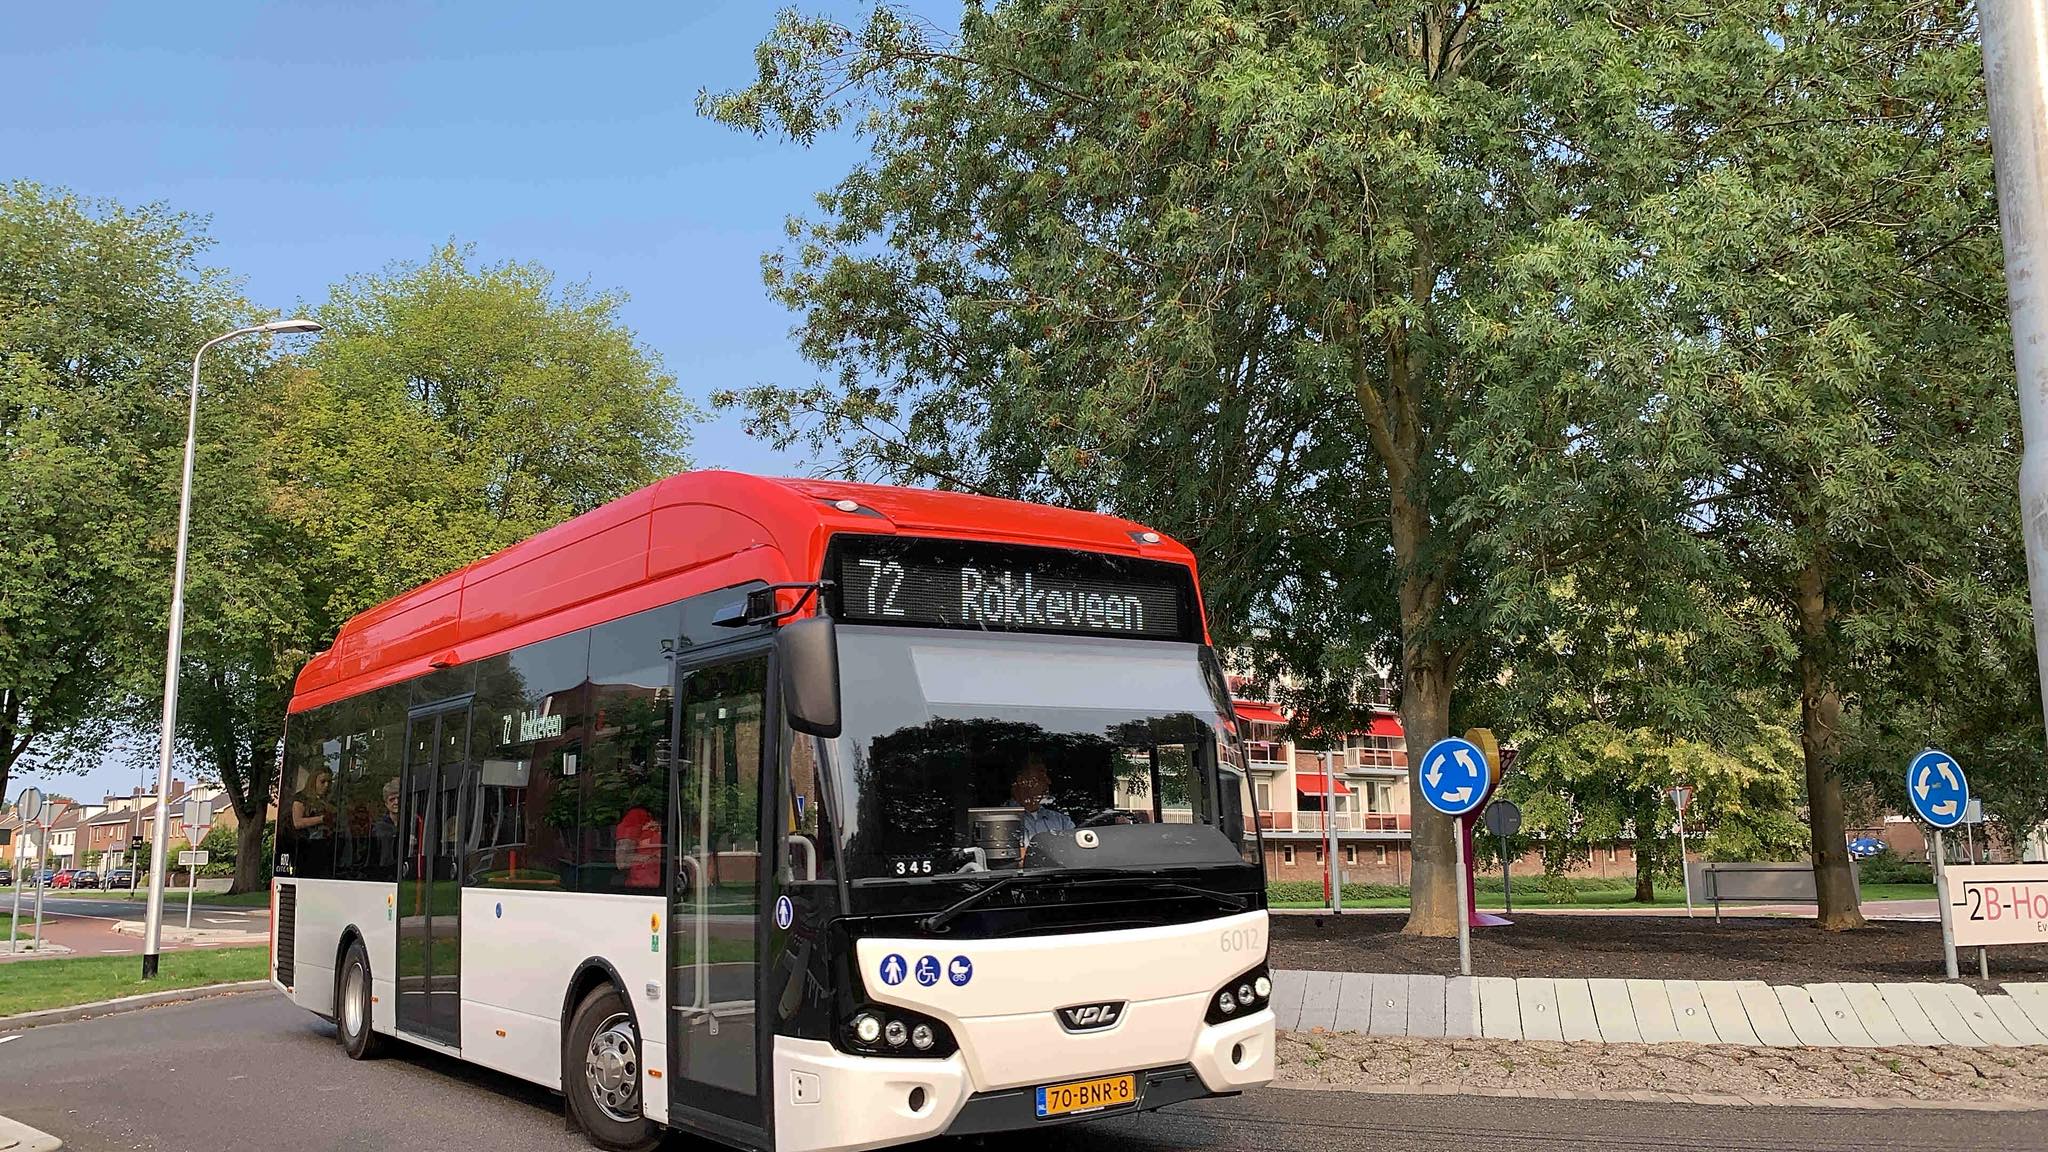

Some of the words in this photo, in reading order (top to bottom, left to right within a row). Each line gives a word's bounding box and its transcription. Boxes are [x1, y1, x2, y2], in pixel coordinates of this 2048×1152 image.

[859, 559, 905, 616] 72
[961, 567, 1144, 631] Rokkeveen
[1220, 928, 1260, 952] 6012
[1065, 1005, 1116, 1025] VDL
[1051, 1080, 1128, 1110] 70-BNR-8
